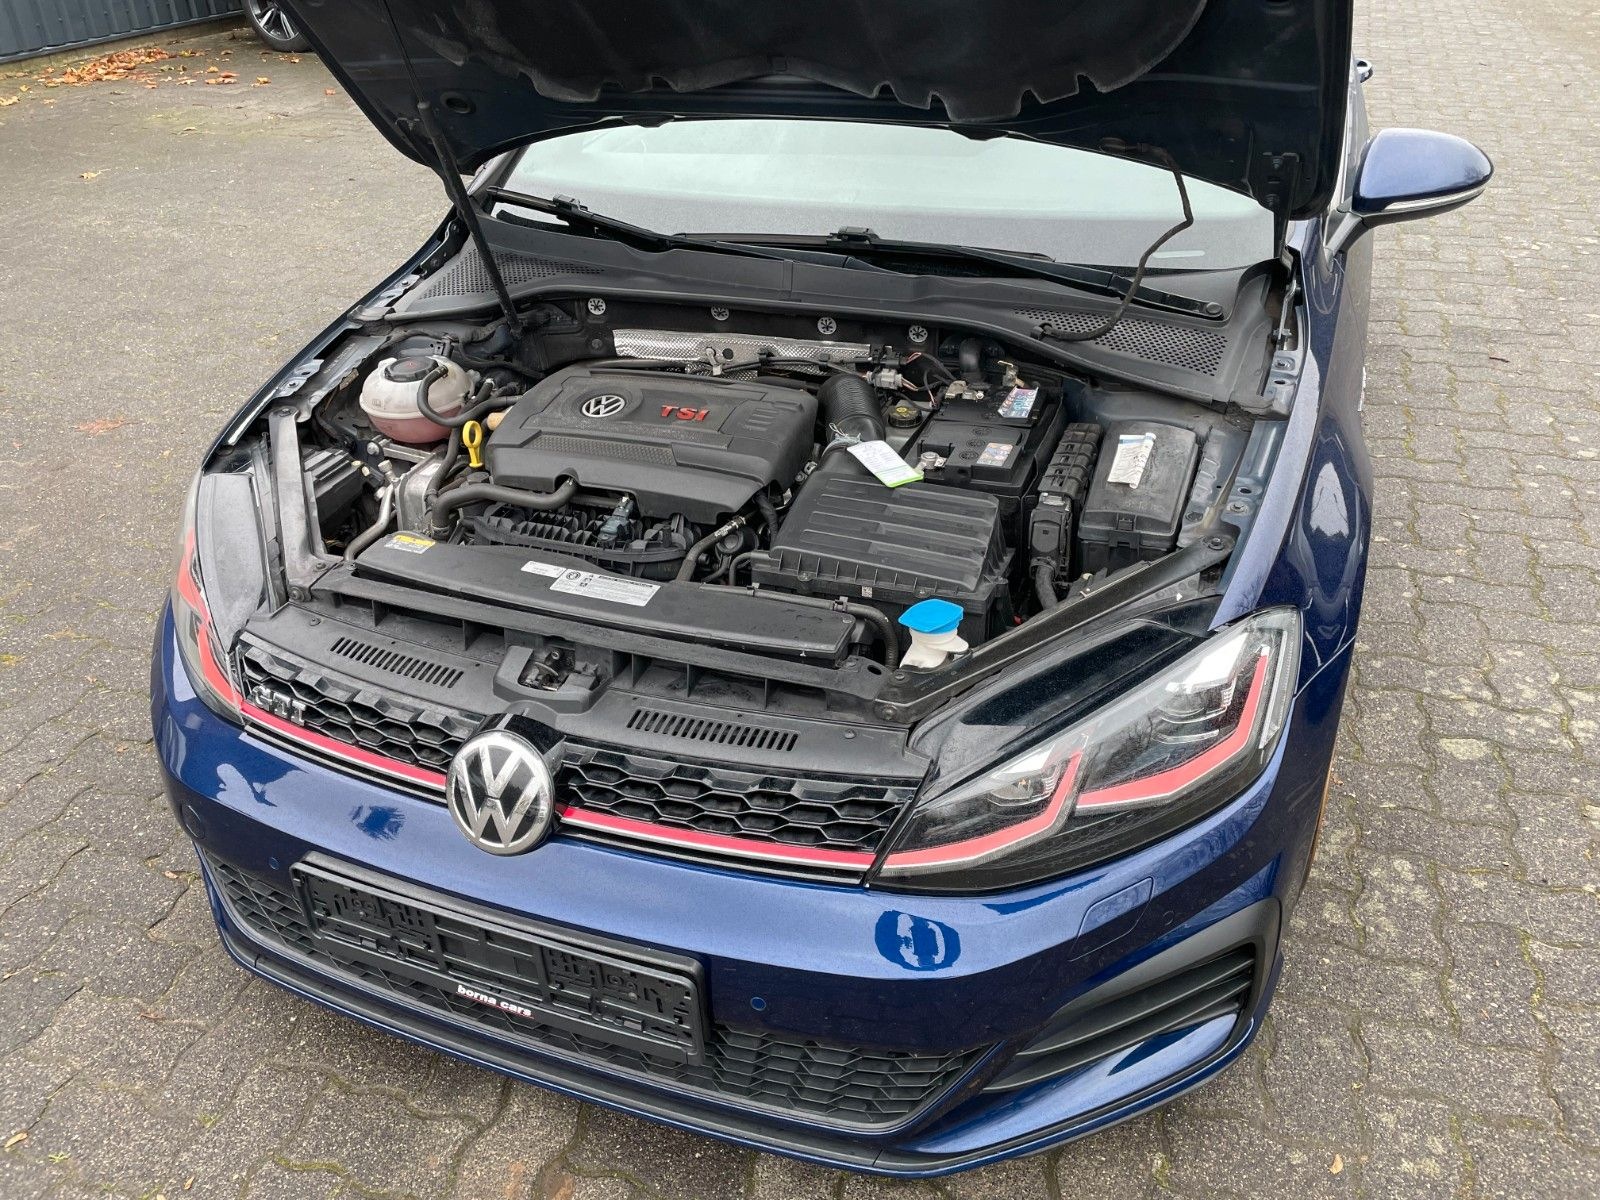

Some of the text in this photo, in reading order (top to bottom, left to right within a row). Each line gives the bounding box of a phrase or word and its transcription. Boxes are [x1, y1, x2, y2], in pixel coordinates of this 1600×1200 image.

[582, 394, 626, 418] VW
[660, 404, 710, 421] TSI
[252, 685, 306, 727] GTI
[448, 732, 553, 853] VW
[456, 984, 532, 1017] borna cars
